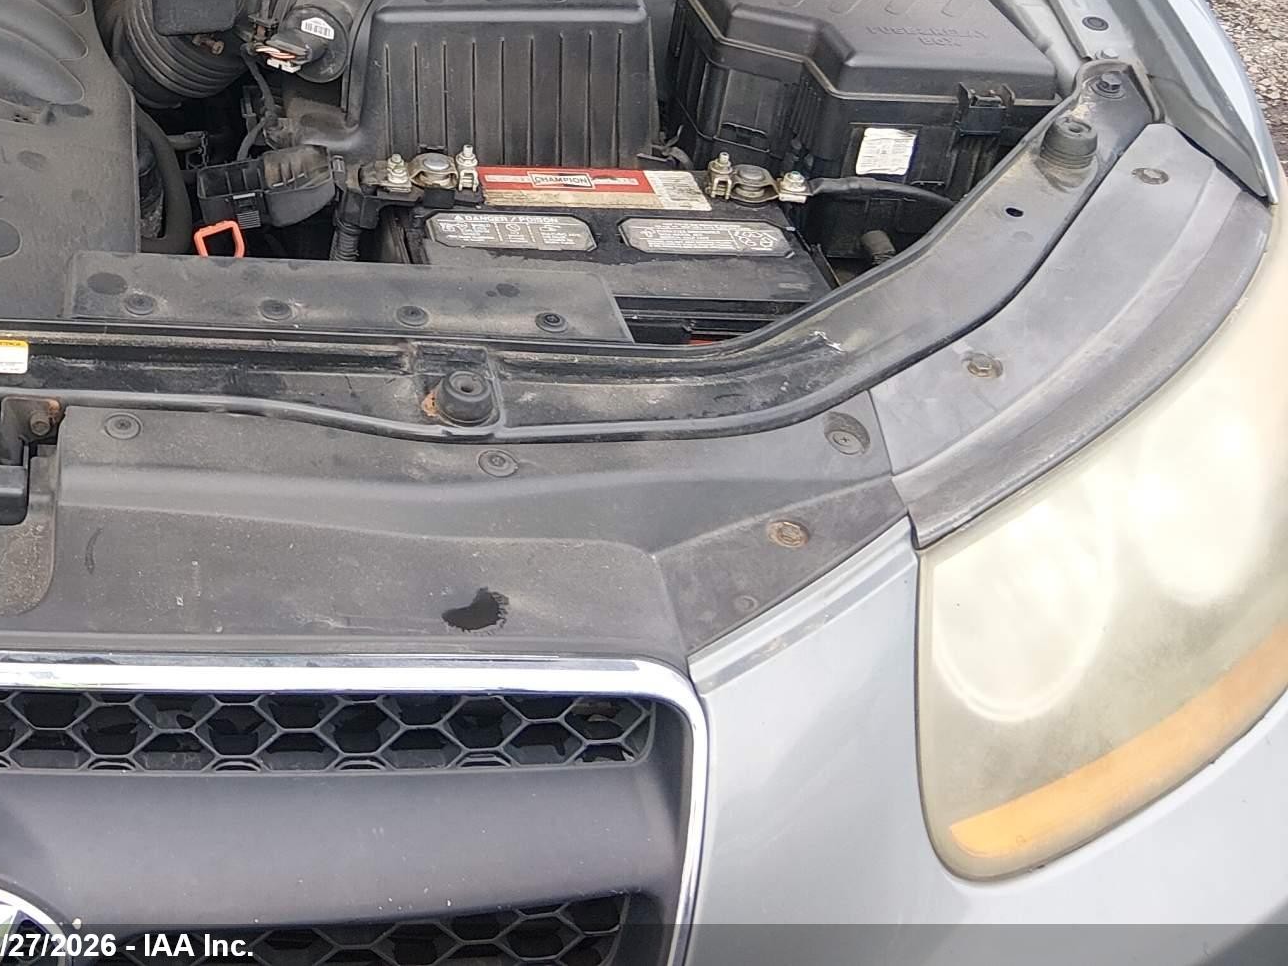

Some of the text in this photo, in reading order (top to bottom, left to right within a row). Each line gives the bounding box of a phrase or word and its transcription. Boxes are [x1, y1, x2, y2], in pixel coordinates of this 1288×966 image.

[533, 176, 588, 185] CHAMPION
[465, 215, 508, 223] DANGER
[519, 216, 559, 224] POISON
